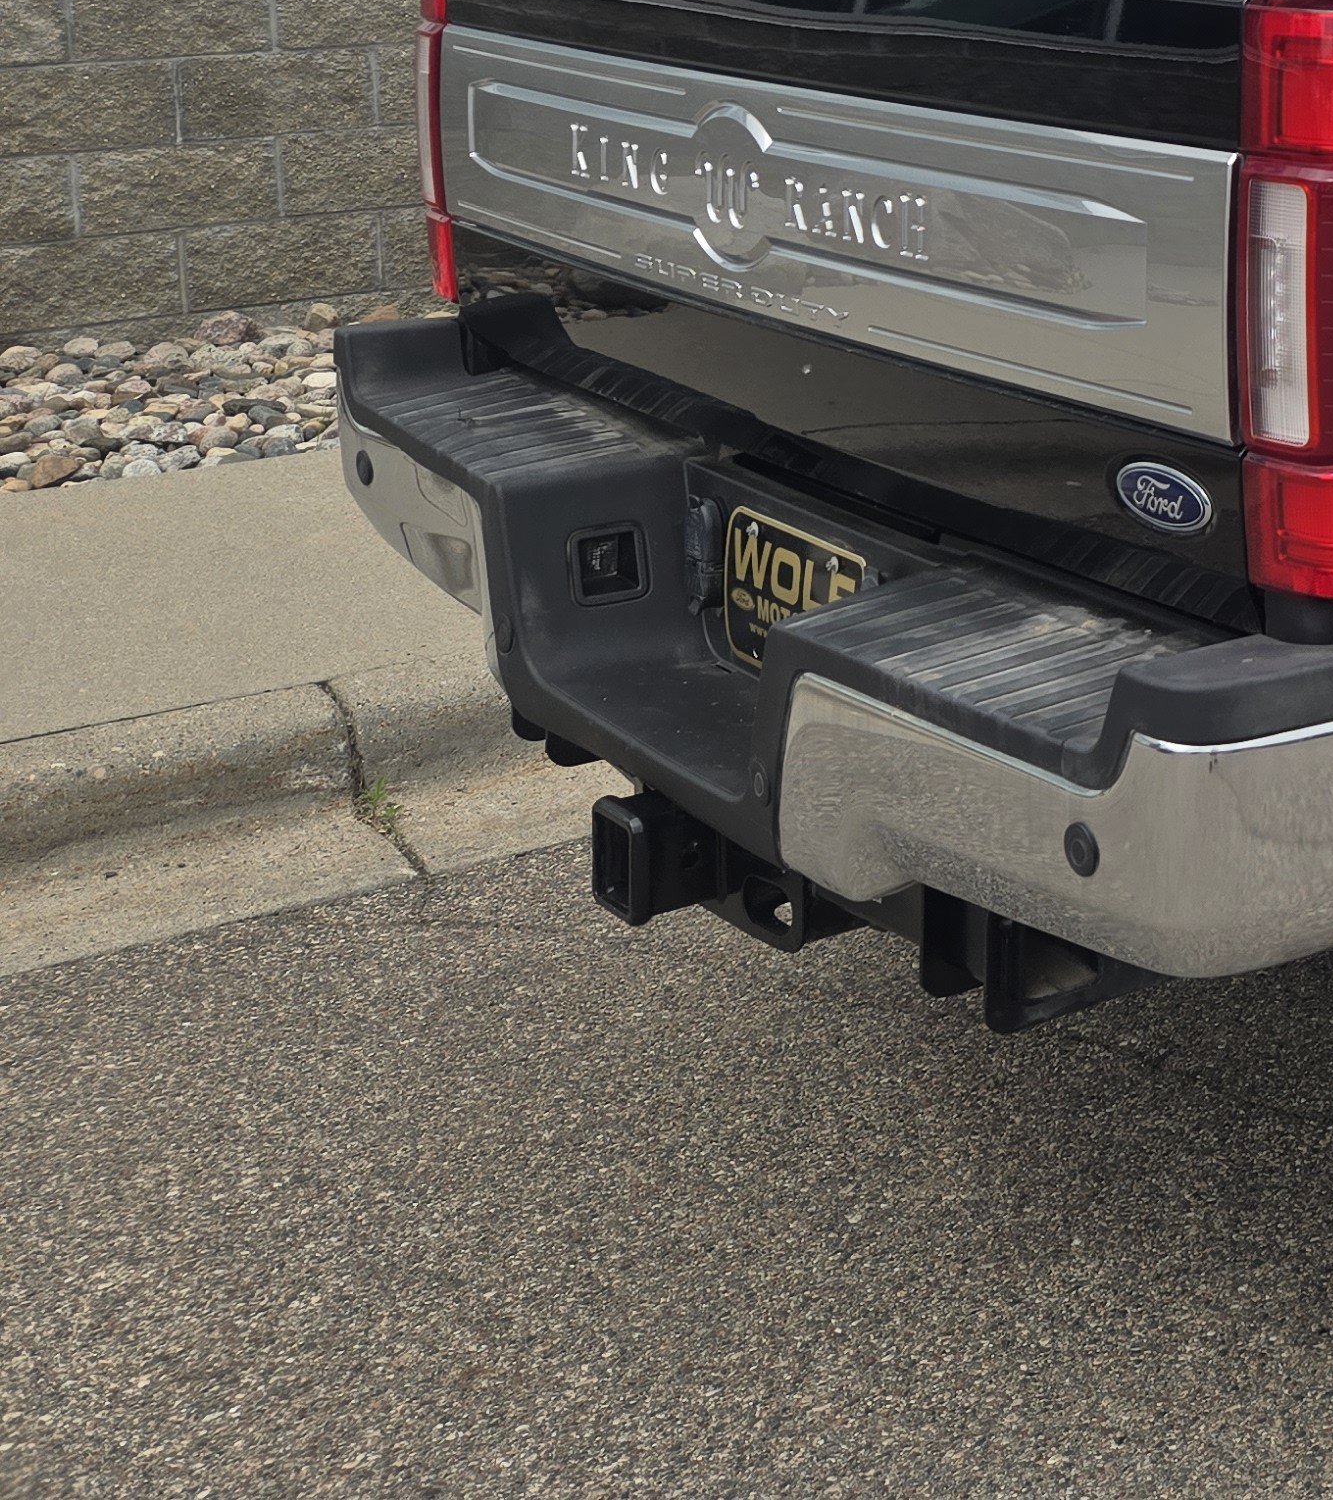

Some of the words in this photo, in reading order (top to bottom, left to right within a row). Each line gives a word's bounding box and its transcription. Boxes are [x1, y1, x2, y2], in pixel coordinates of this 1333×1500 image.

[570, 122, 669, 196] KING
[784, 176, 930, 261] RANCH
[1132, 474, 1184, 521] Ford
[734, 526, 857, 611] WOLF
